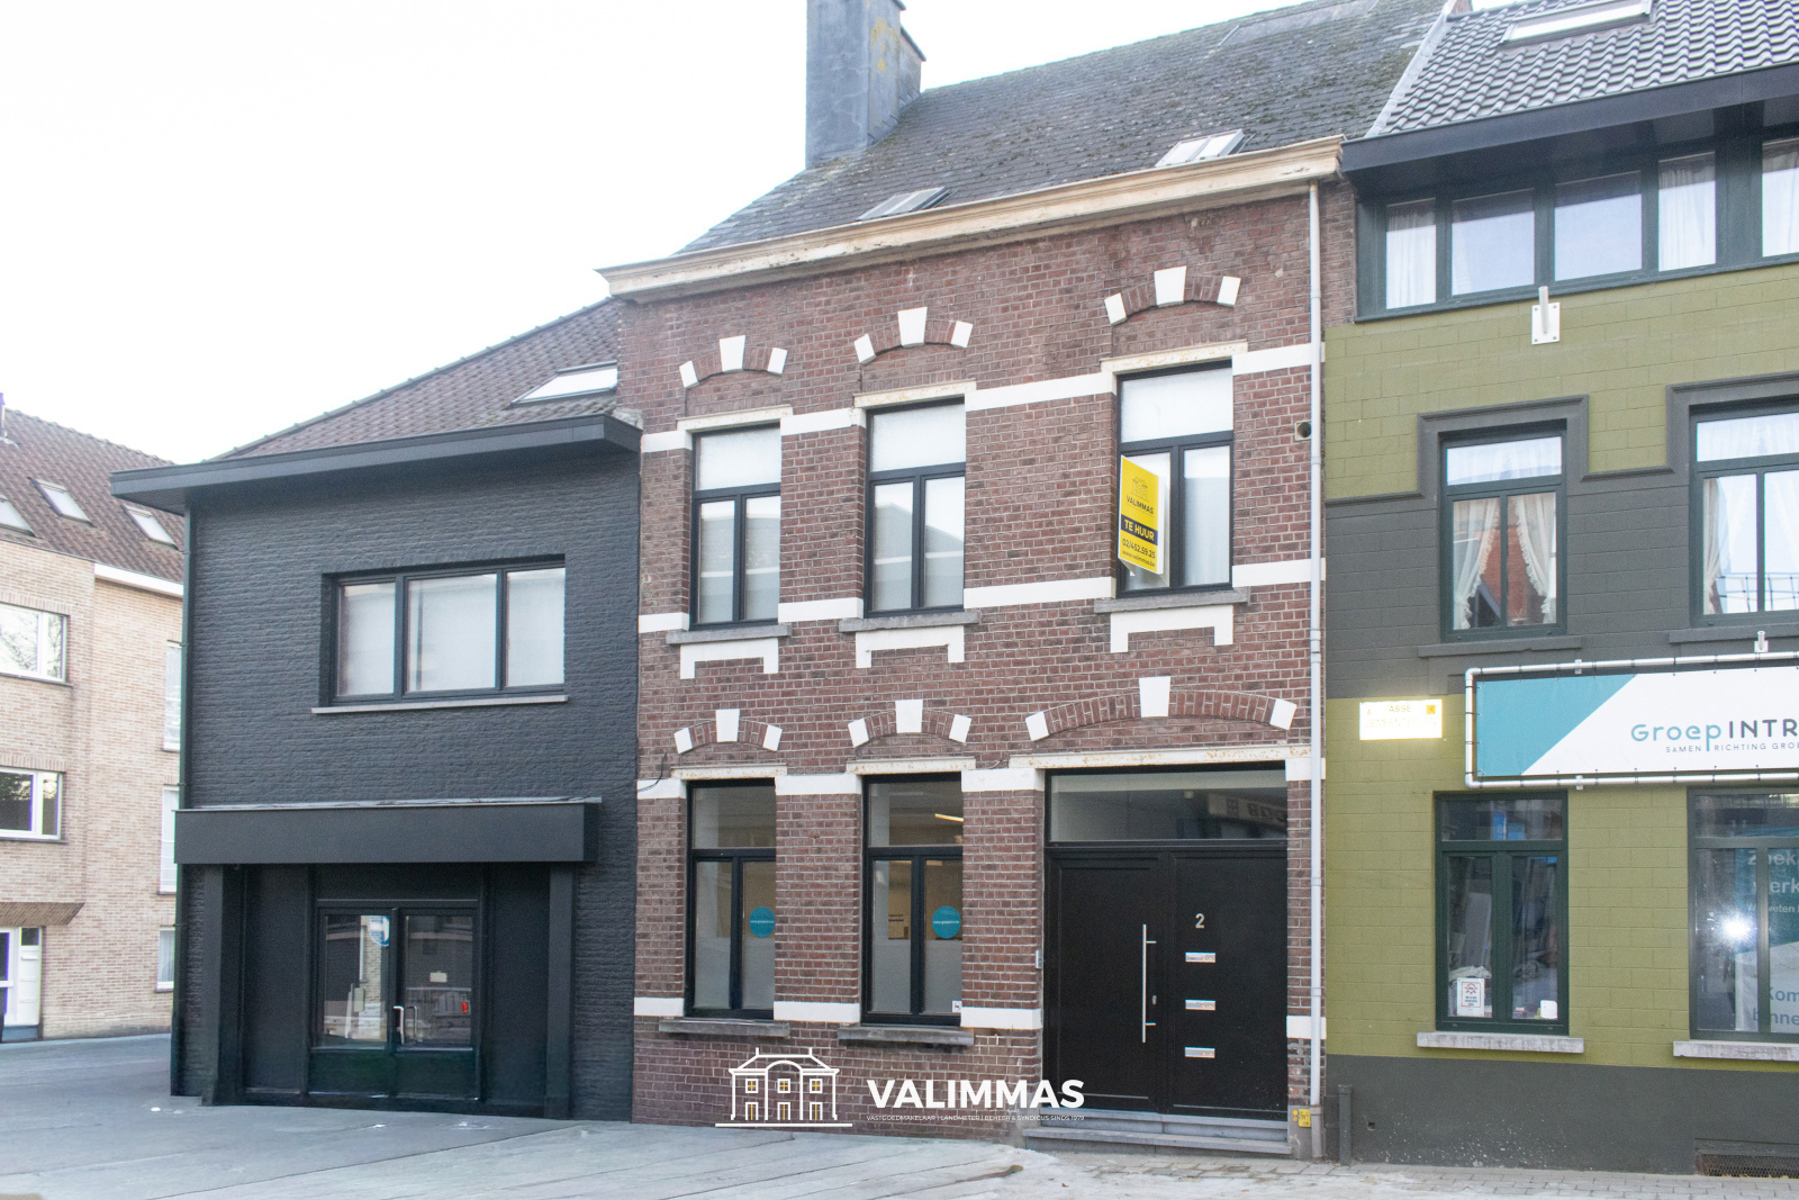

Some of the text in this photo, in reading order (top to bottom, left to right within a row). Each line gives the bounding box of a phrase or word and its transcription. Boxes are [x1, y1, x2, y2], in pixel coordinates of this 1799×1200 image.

[1126, 494, 1154, 515] VALIMMAS
[1123, 518, 1155, 542] TE HUUR
[1631, 723, 1722, 752] Groep
[1665, 745, 1702, 754] SAMEN
[1715, 742, 1767, 753] RICHTING
[1195, 912, 1205, 929] 2
